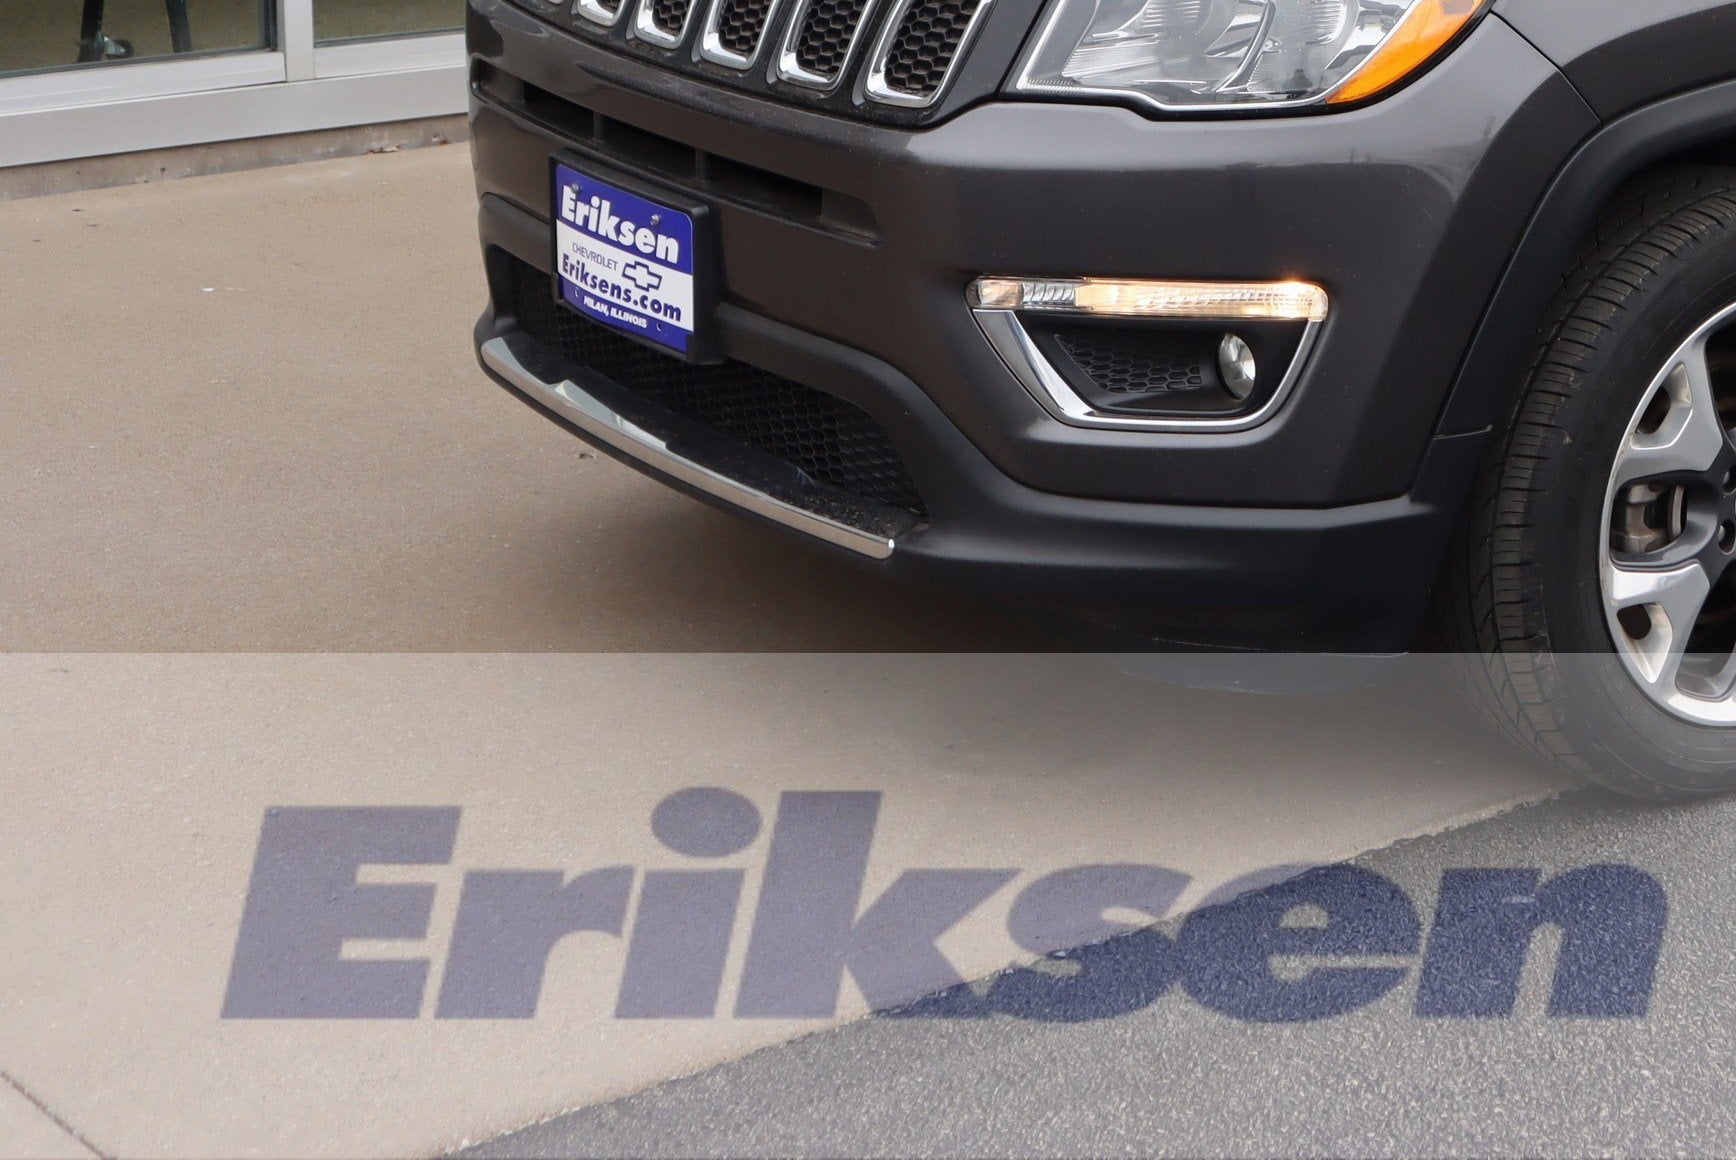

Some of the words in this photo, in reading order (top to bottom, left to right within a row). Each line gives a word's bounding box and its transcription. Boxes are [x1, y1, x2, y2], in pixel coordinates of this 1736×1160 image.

[561, 184, 679, 264] Eriksen
[572, 242, 618, 271] CHEVROLET
[562, 252, 682, 322] Eriksens.com
